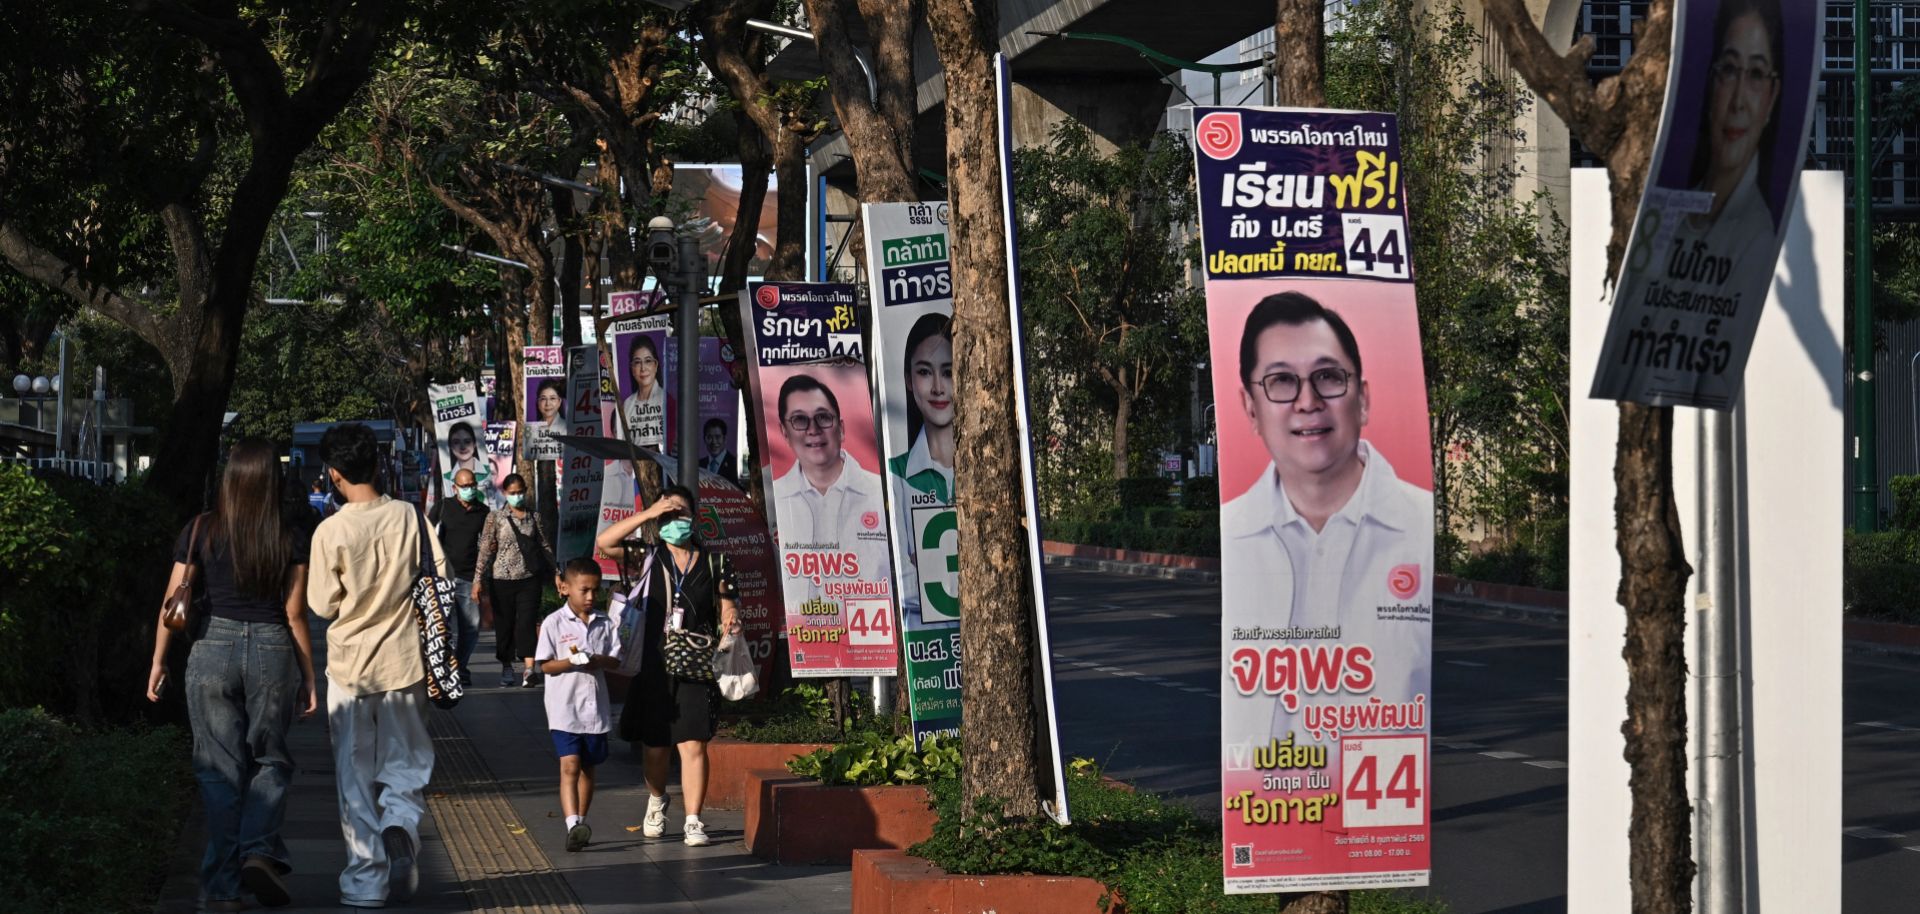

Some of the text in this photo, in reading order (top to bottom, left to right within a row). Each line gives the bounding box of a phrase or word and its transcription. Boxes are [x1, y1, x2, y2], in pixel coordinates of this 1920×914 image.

[1250, 123, 1388, 147] พรรคโอกาสใหม่
[1221, 150, 1398, 209] เรียน ฟรี!
[909, 202, 932, 216] กล้า
[910, 216, 933, 225] ธรรม
[1230, 214, 1323, 238] ถึง ป.ตรี
[887, 237, 942, 263] กล้าทำ
[1209, 241, 1286, 274] ปลดหนี้
[1349, 227, 1404, 274] 44
[1667, 239, 1732, 286] ไม่โกง
[889, 267, 951, 301] ทำจริ
[1644, 281, 1742, 318] มีประสบการณ์
[615, 318, 666, 332] ไทยสร้างไทย
[762, 311, 823, 338] รักษา
[763, 341, 826, 364] ทุกที่มีหมอ
[1622, 315, 1732, 376] ทำสำเร็จ
[911, 490, 936, 505] เบอร์
[785, 551, 860, 587] จตุพร
[825, 577, 889, 601] บุรุษพัฒน์
[800, 595, 838, 615] เปลี่ยน
[850, 608, 891, 637] 44
[1231, 626, 1341, 640] หัวหน้าพรรคโอกาสใหม่
[908, 638, 948, 662] น.ส.
[1231, 645, 1375, 712] จตุพร
[1304, 695, 1425, 741] บุรุษพัฒน์
[1253, 731, 1327, 769] เปลี่ยน
[1344, 742, 1362, 751] เบอร์
[1263, 772, 1330, 794] วิกฤต เป็น
[1346, 755, 1421, 810] 44
